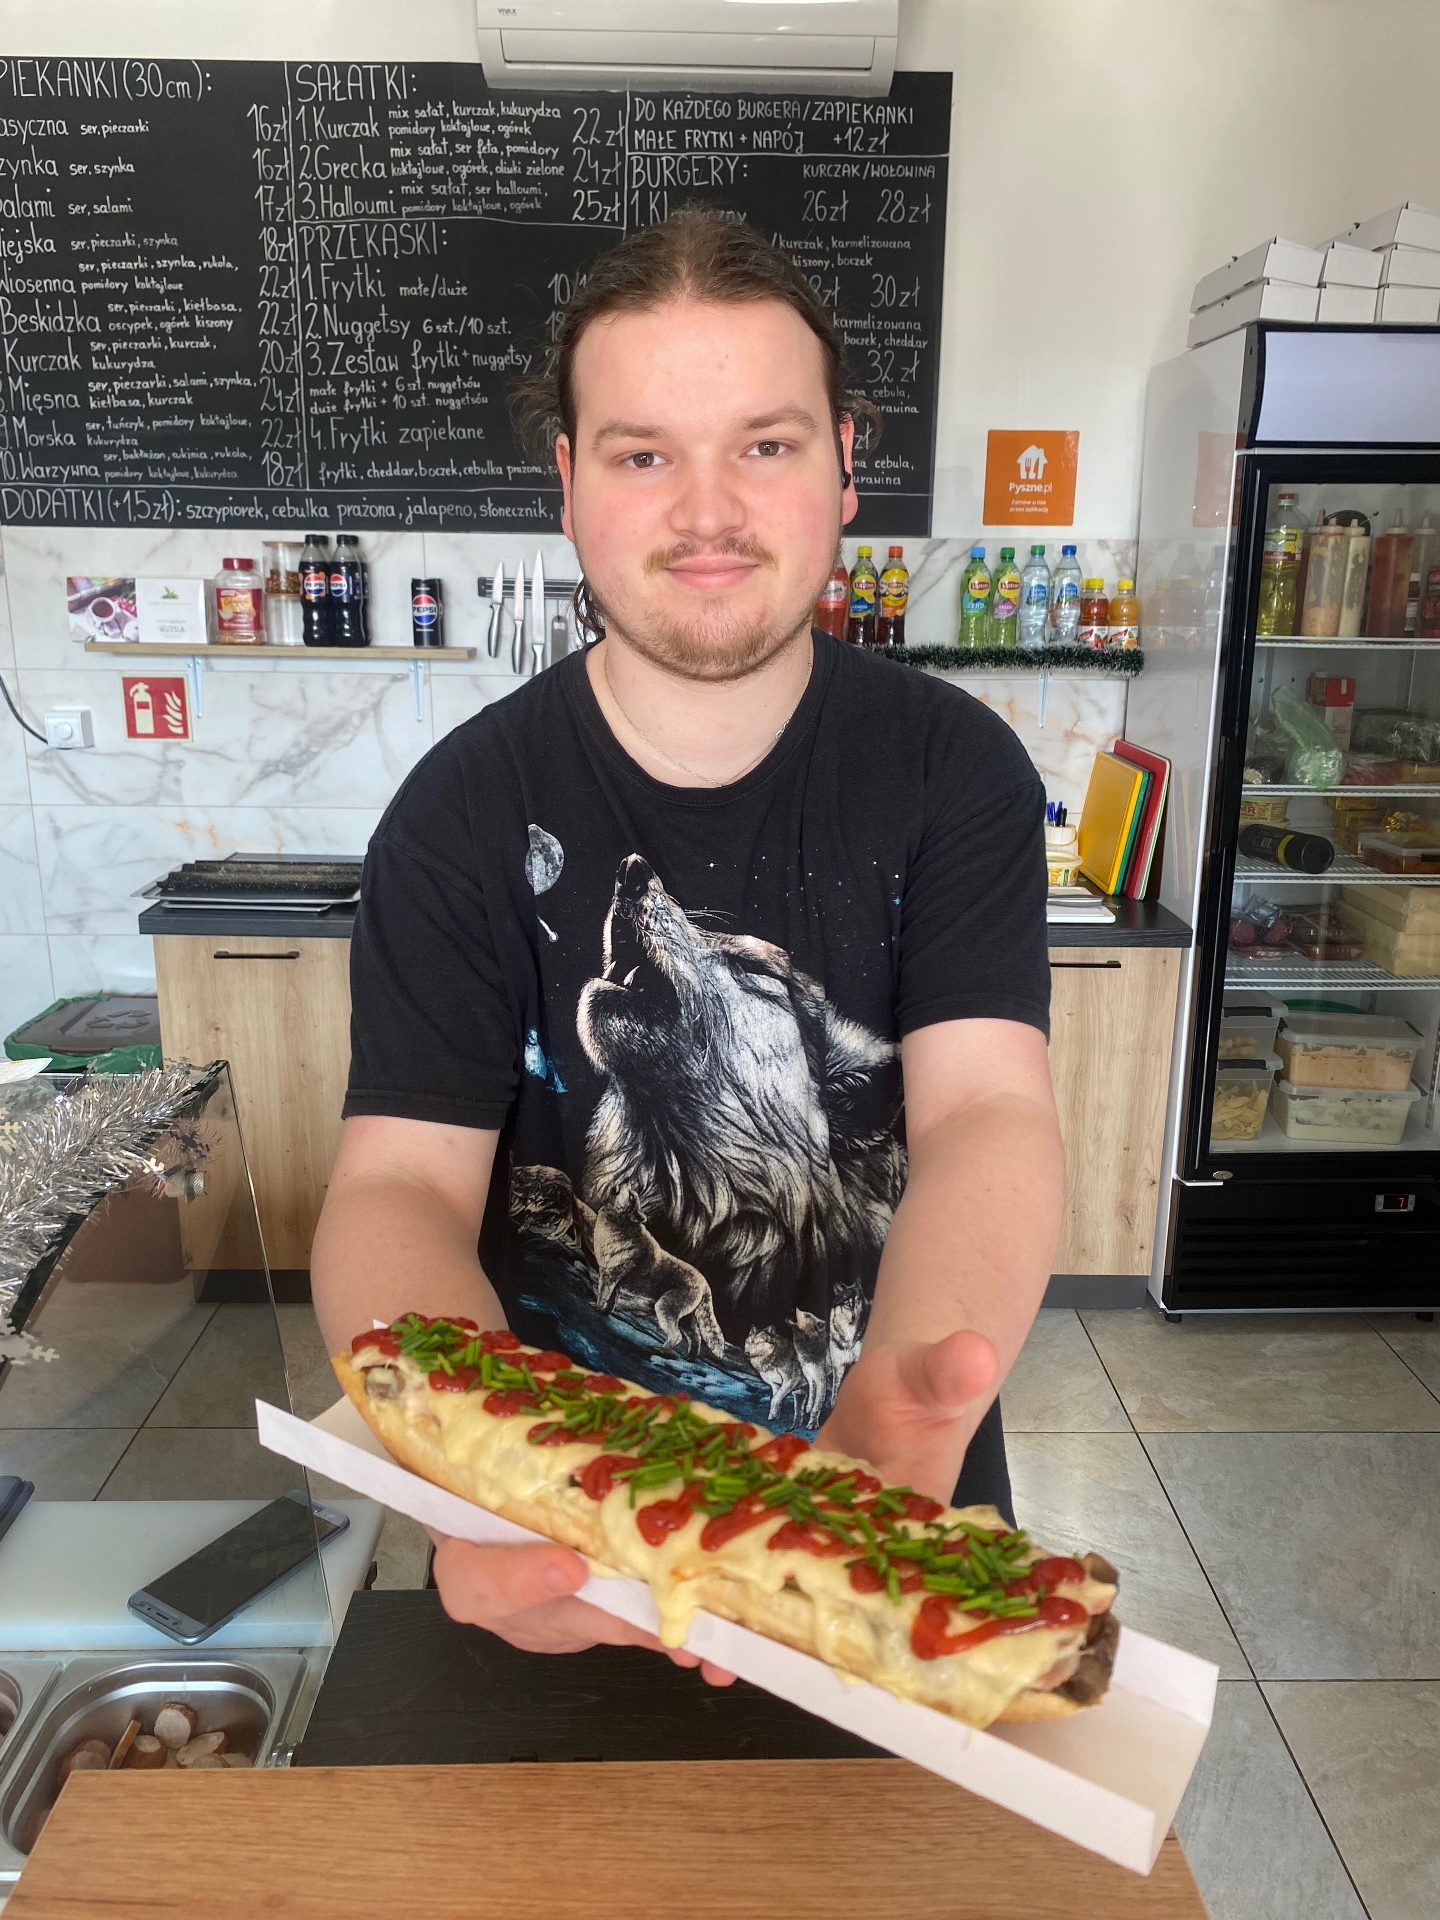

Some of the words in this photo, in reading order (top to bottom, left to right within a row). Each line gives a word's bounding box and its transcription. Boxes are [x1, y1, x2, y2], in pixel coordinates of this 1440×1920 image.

[296, 65, 416, 102] SAŁATKI:
[389, 104, 409, 119] mix
[415, 101, 449, 118] sałat,
[452, 100, 499, 117] kurczak,
[501, 101, 561, 122] kukurydza
[635, 98, 655, 121] DO
[663, 95, 731, 120] KAŻDEGO
[388, 124, 435, 138] pomidory
[497, 120, 532, 139] ogórek
[635, 128, 677, 150] MAŁE
[685, 129, 733, 149] FRYTKI
[752, 122, 804, 154] NAPÓJ
[390, 141, 412, 158] mix
[455, 144, 472, 153] ser
[505, 141, 559, 159] pomidory
[452, 159, 493, 178] ogórek,
[495, 159, 522, 174] oliwki
[526, 159, 564, 175] zielone
[630, 155, 749, 188] BURGERY:
[401, 180, 423, 194] mix
[475, 186, 491, 194] ser
[93, 195, 133, 214] salami
[402, 203, 446, 218] pomidory
[510, 197, 542, 213] ogórek
[0, 221, 56, 264] iejska
[143, 233, 178, 249] szynka
[299, 221, 447, 261] PRZEKĄSKI:
[838, 252, 873, 266] boczek
[81, 278, 128, 295] pomidory
[399, 274, 468, 298] małe/duże
[0, 296, 102, 335] Beskidzka
[160, 315, 190, 334] ogórek
[195, 315, 233, 336] kiszony
[885, 333, 928, 348] cheddar
[92, 355, 156, 374] kukurydza
[310, 383, 336, 397] małe
[343, 379, 376, 397] frytki
[147, 390, 193, 406] kurczak
[310, 402, 337, 415] duże
[344, 395, 377, 413] frytki
[152, 415, 194, 431] pomidory
[87, 434, 138, 447] kukurydza
[399, 416, 485, 451] zapiekane
[463, 460, 503, 475] cebulka
[875, 455, 914, 470] cebula,
[105, 466, 143, 483] pomidory
[1009, 482, 1053, 495] Pyszne.pl
[1, 488, 103, 520] DODATKI
[186, 496, 268, 522] szczypiorek,
[272, 497, 330, 518] cebulka
[337, 497, 402, 525] prażona,
[405, 497, 476, 524] jalapeno,
[480, 497, 553, 519] słonecznik,
[413, 606, 437, 614] PEPSI
[1399, 1197, 1405, 1208] 7
